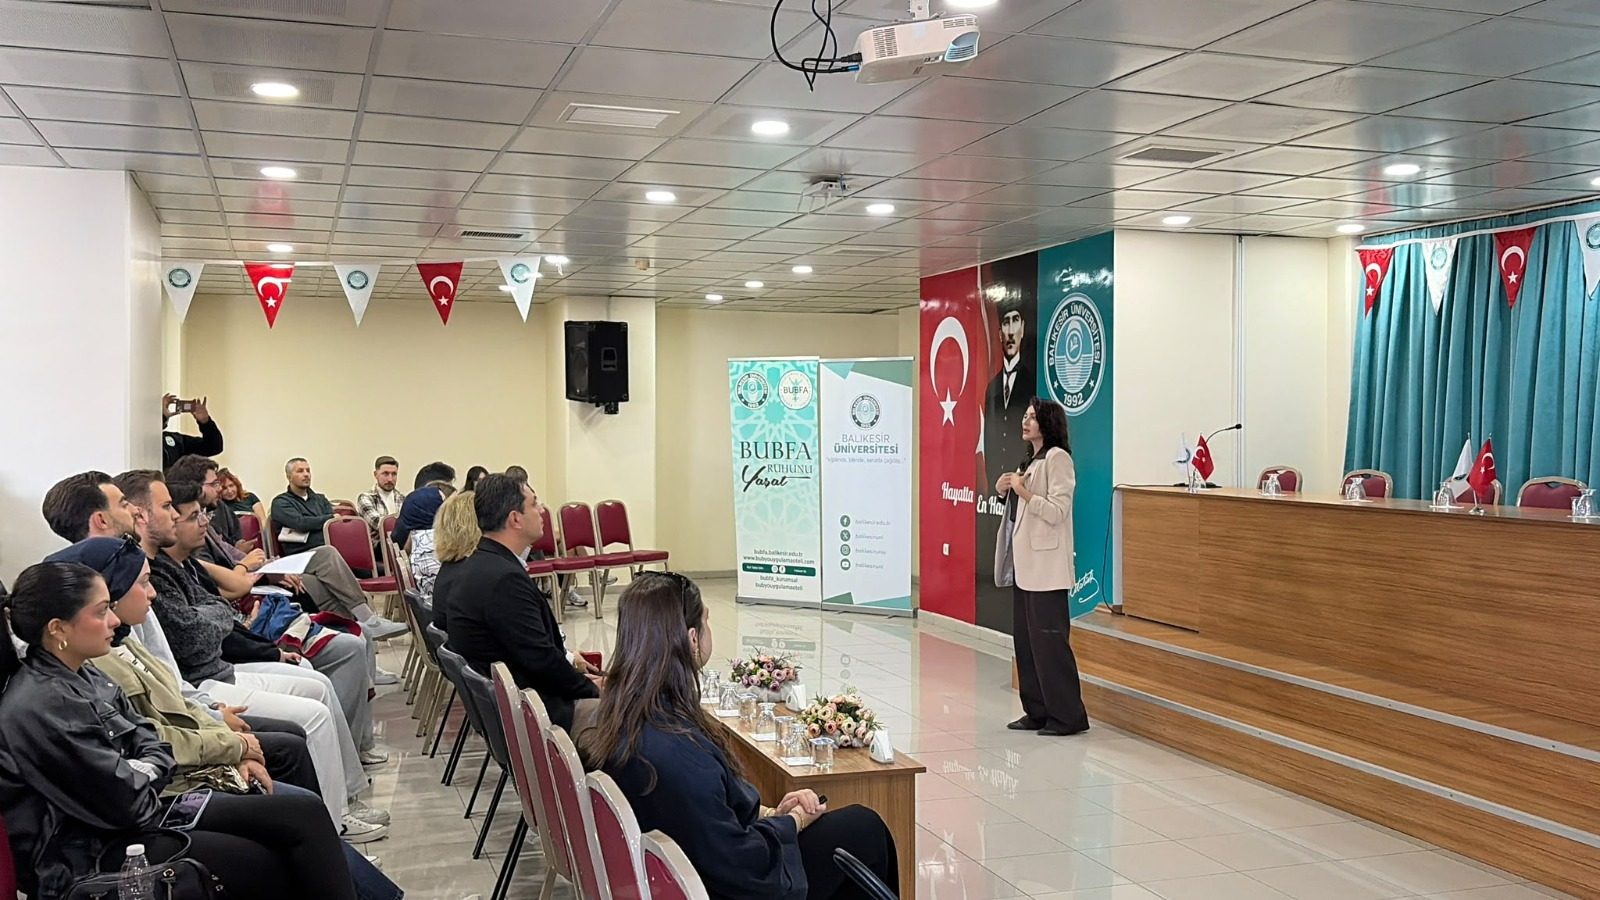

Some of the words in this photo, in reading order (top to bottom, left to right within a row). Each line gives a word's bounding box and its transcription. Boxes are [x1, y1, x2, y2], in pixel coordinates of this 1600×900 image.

[1048, 310, 1069, 366] BALIKESİR
[783, 386, 809, 394] BUBFA
[1063, 393, 1084, 406] 1992
[842, 433, 890, 443] BALIKESİR
[739, 441, 812, 460] BUBFA
[834, 443, 899, 454] ÜNİVERSİTESİ
[767, 464, 813, 474] RUHUNU
[941, 482, 974, 507] Hayatta
[976, 495, 987, 514] En
